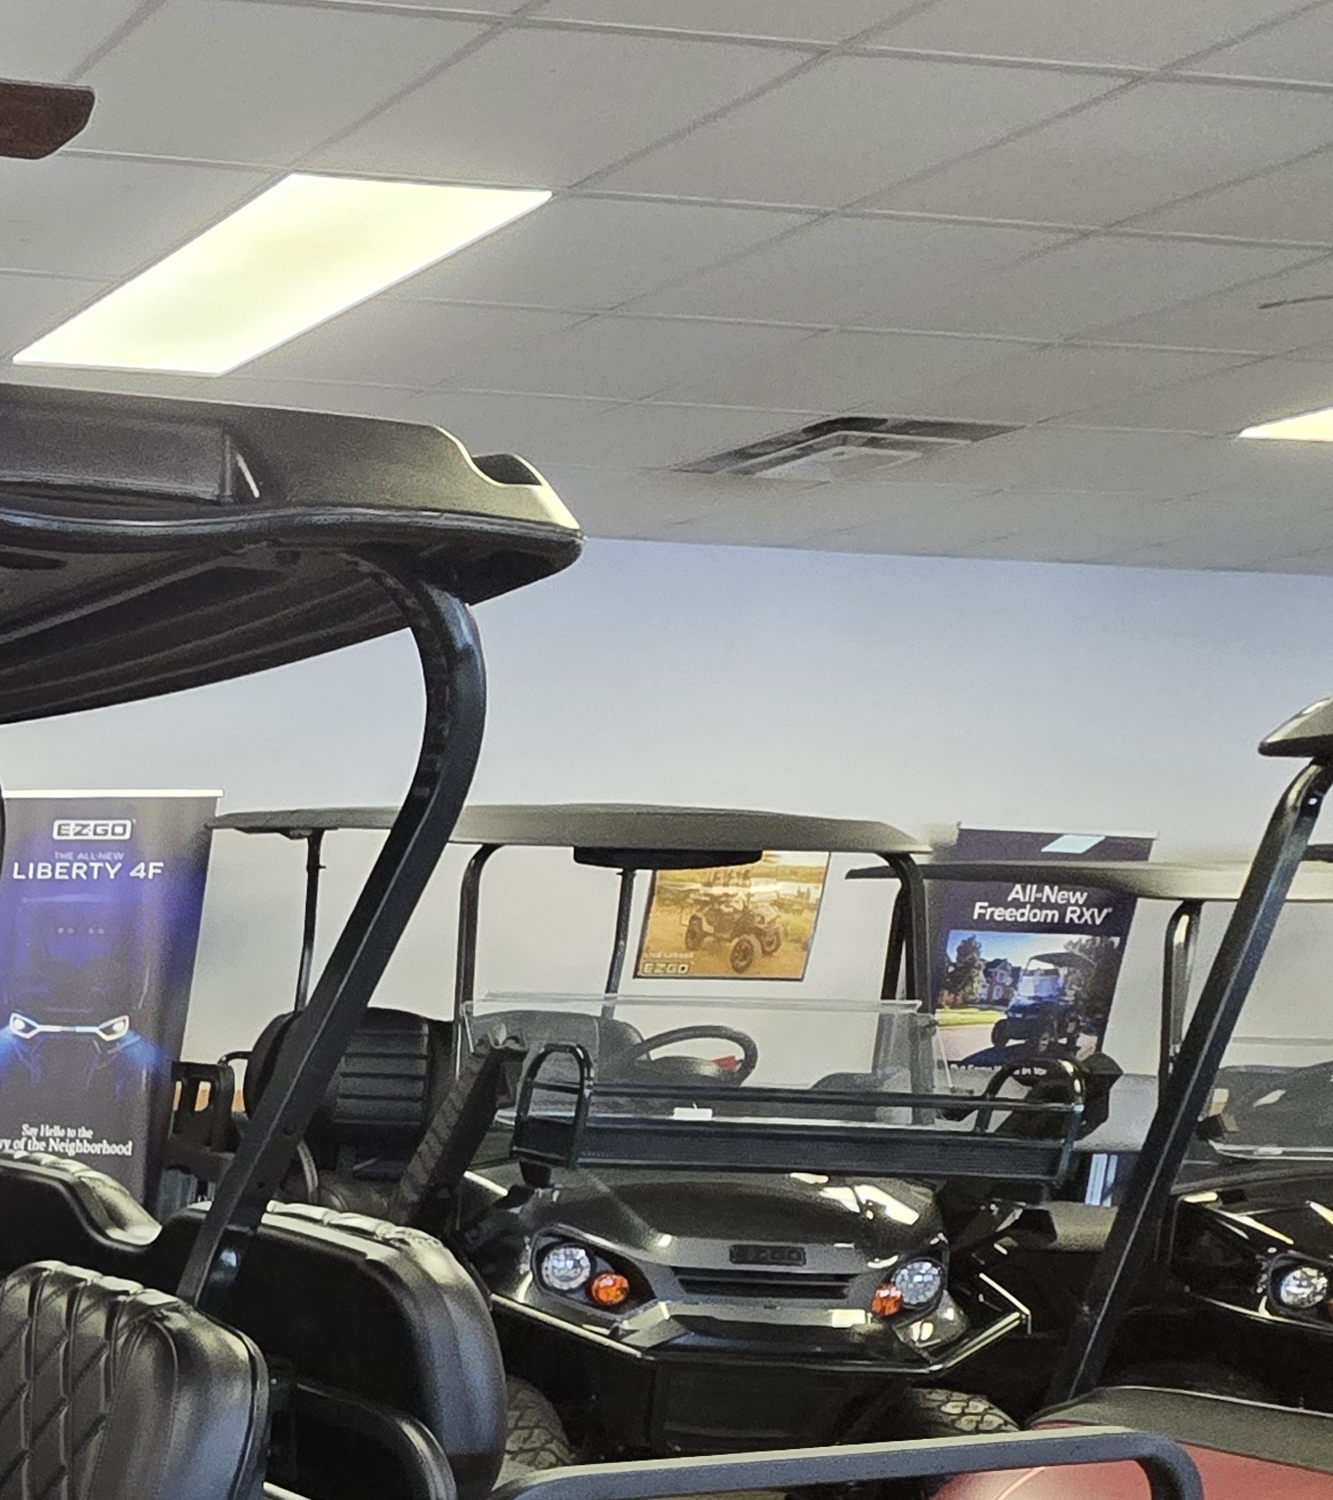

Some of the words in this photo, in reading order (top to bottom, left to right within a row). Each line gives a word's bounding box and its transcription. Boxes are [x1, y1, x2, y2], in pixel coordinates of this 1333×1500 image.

[54, 851, 75, 861] THE
[12, 861, 123, 880] LIBERTY
[129, 861, 165, 880] 4F
[1007, 883, 1088, 905] All-New
[972, 901, 1060, 924] Freedom
[21, 1123, 39, 1138] Say
[39, 1123, 66, 1138] Hello
[66, 1127, 77, 1138] to
[78, 1126, 94, 1139] the
[13, 1136, 28, 1151] of
[27, 1137, 47, 1152] the
[48, 1137, 133, 1157] Neighborhood
